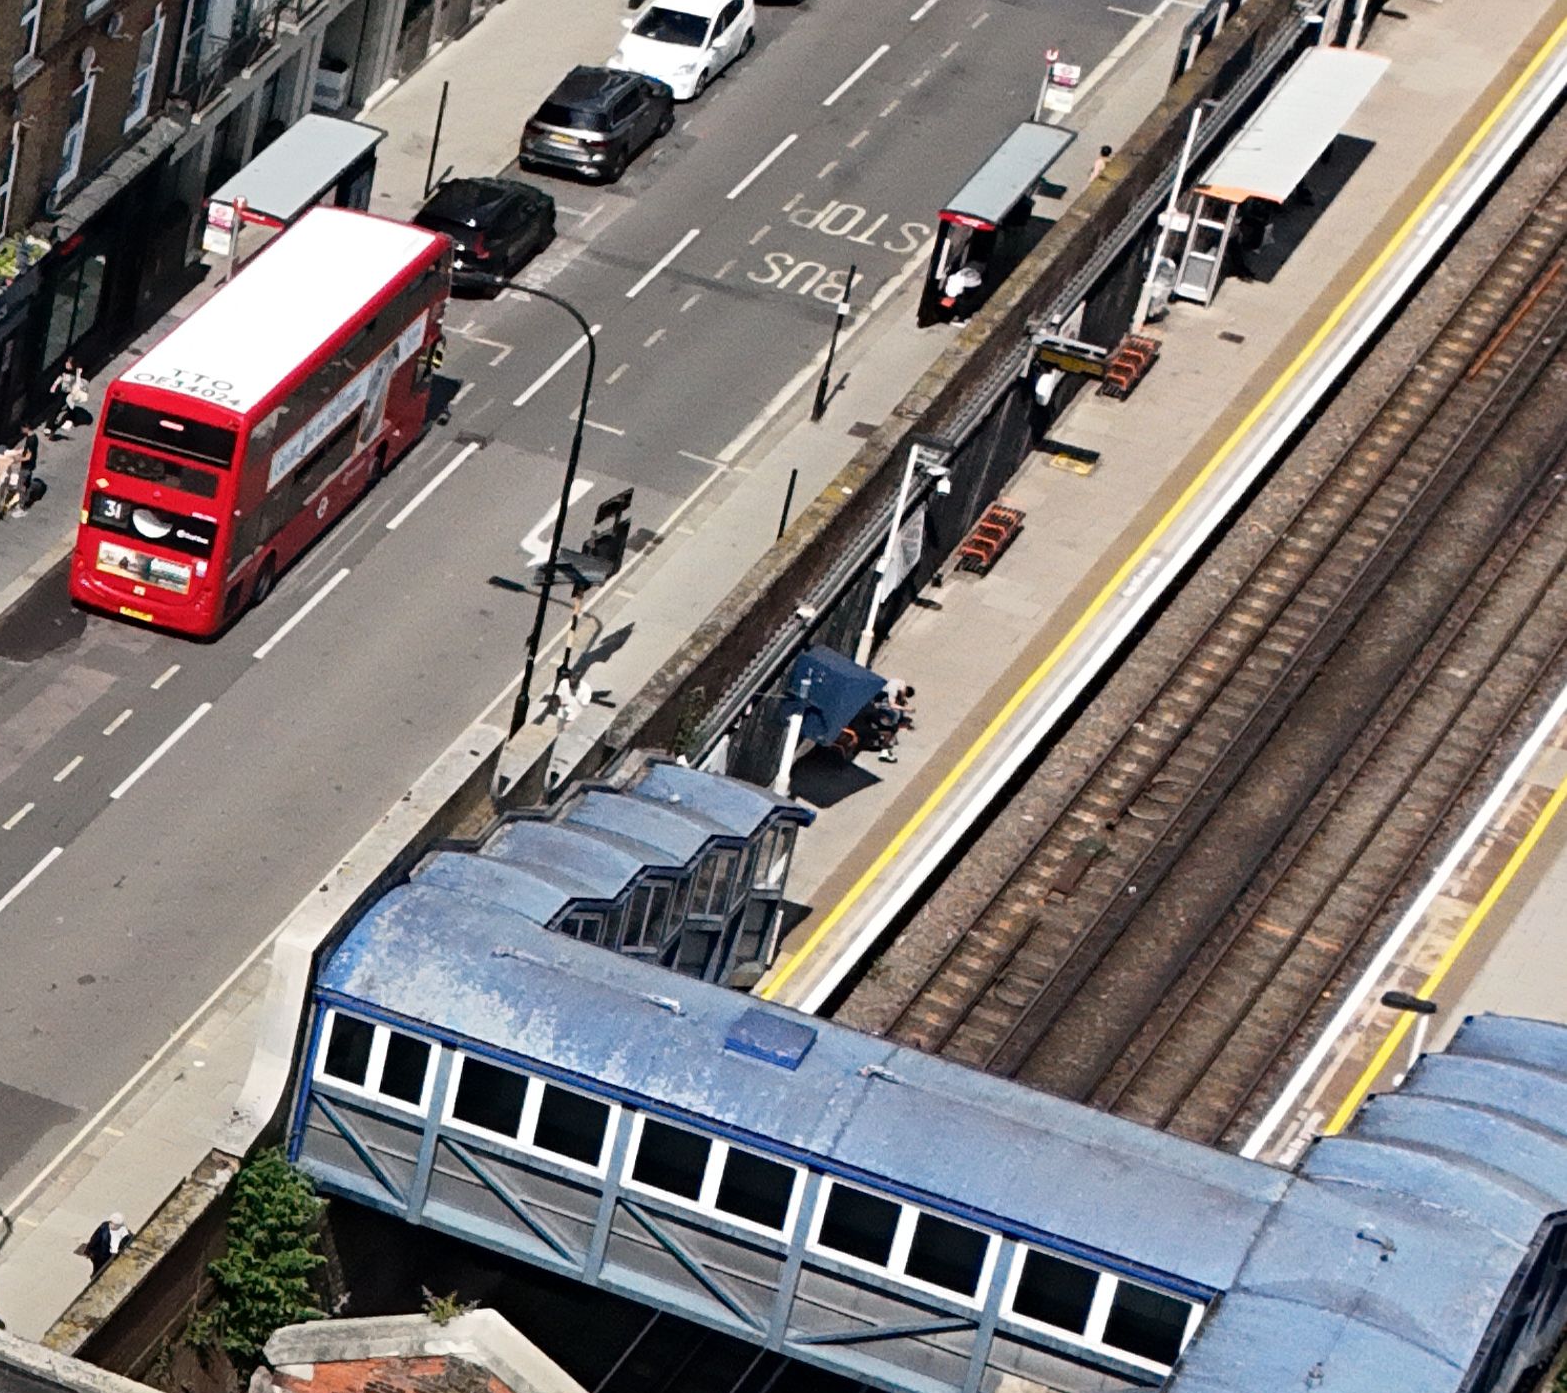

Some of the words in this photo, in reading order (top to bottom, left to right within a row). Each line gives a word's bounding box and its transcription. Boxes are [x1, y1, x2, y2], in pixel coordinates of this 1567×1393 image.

[788, 200, 930, 253] STOP
[747, 252, 864, 304] BUS
[103, 499, 122, 519] 31
